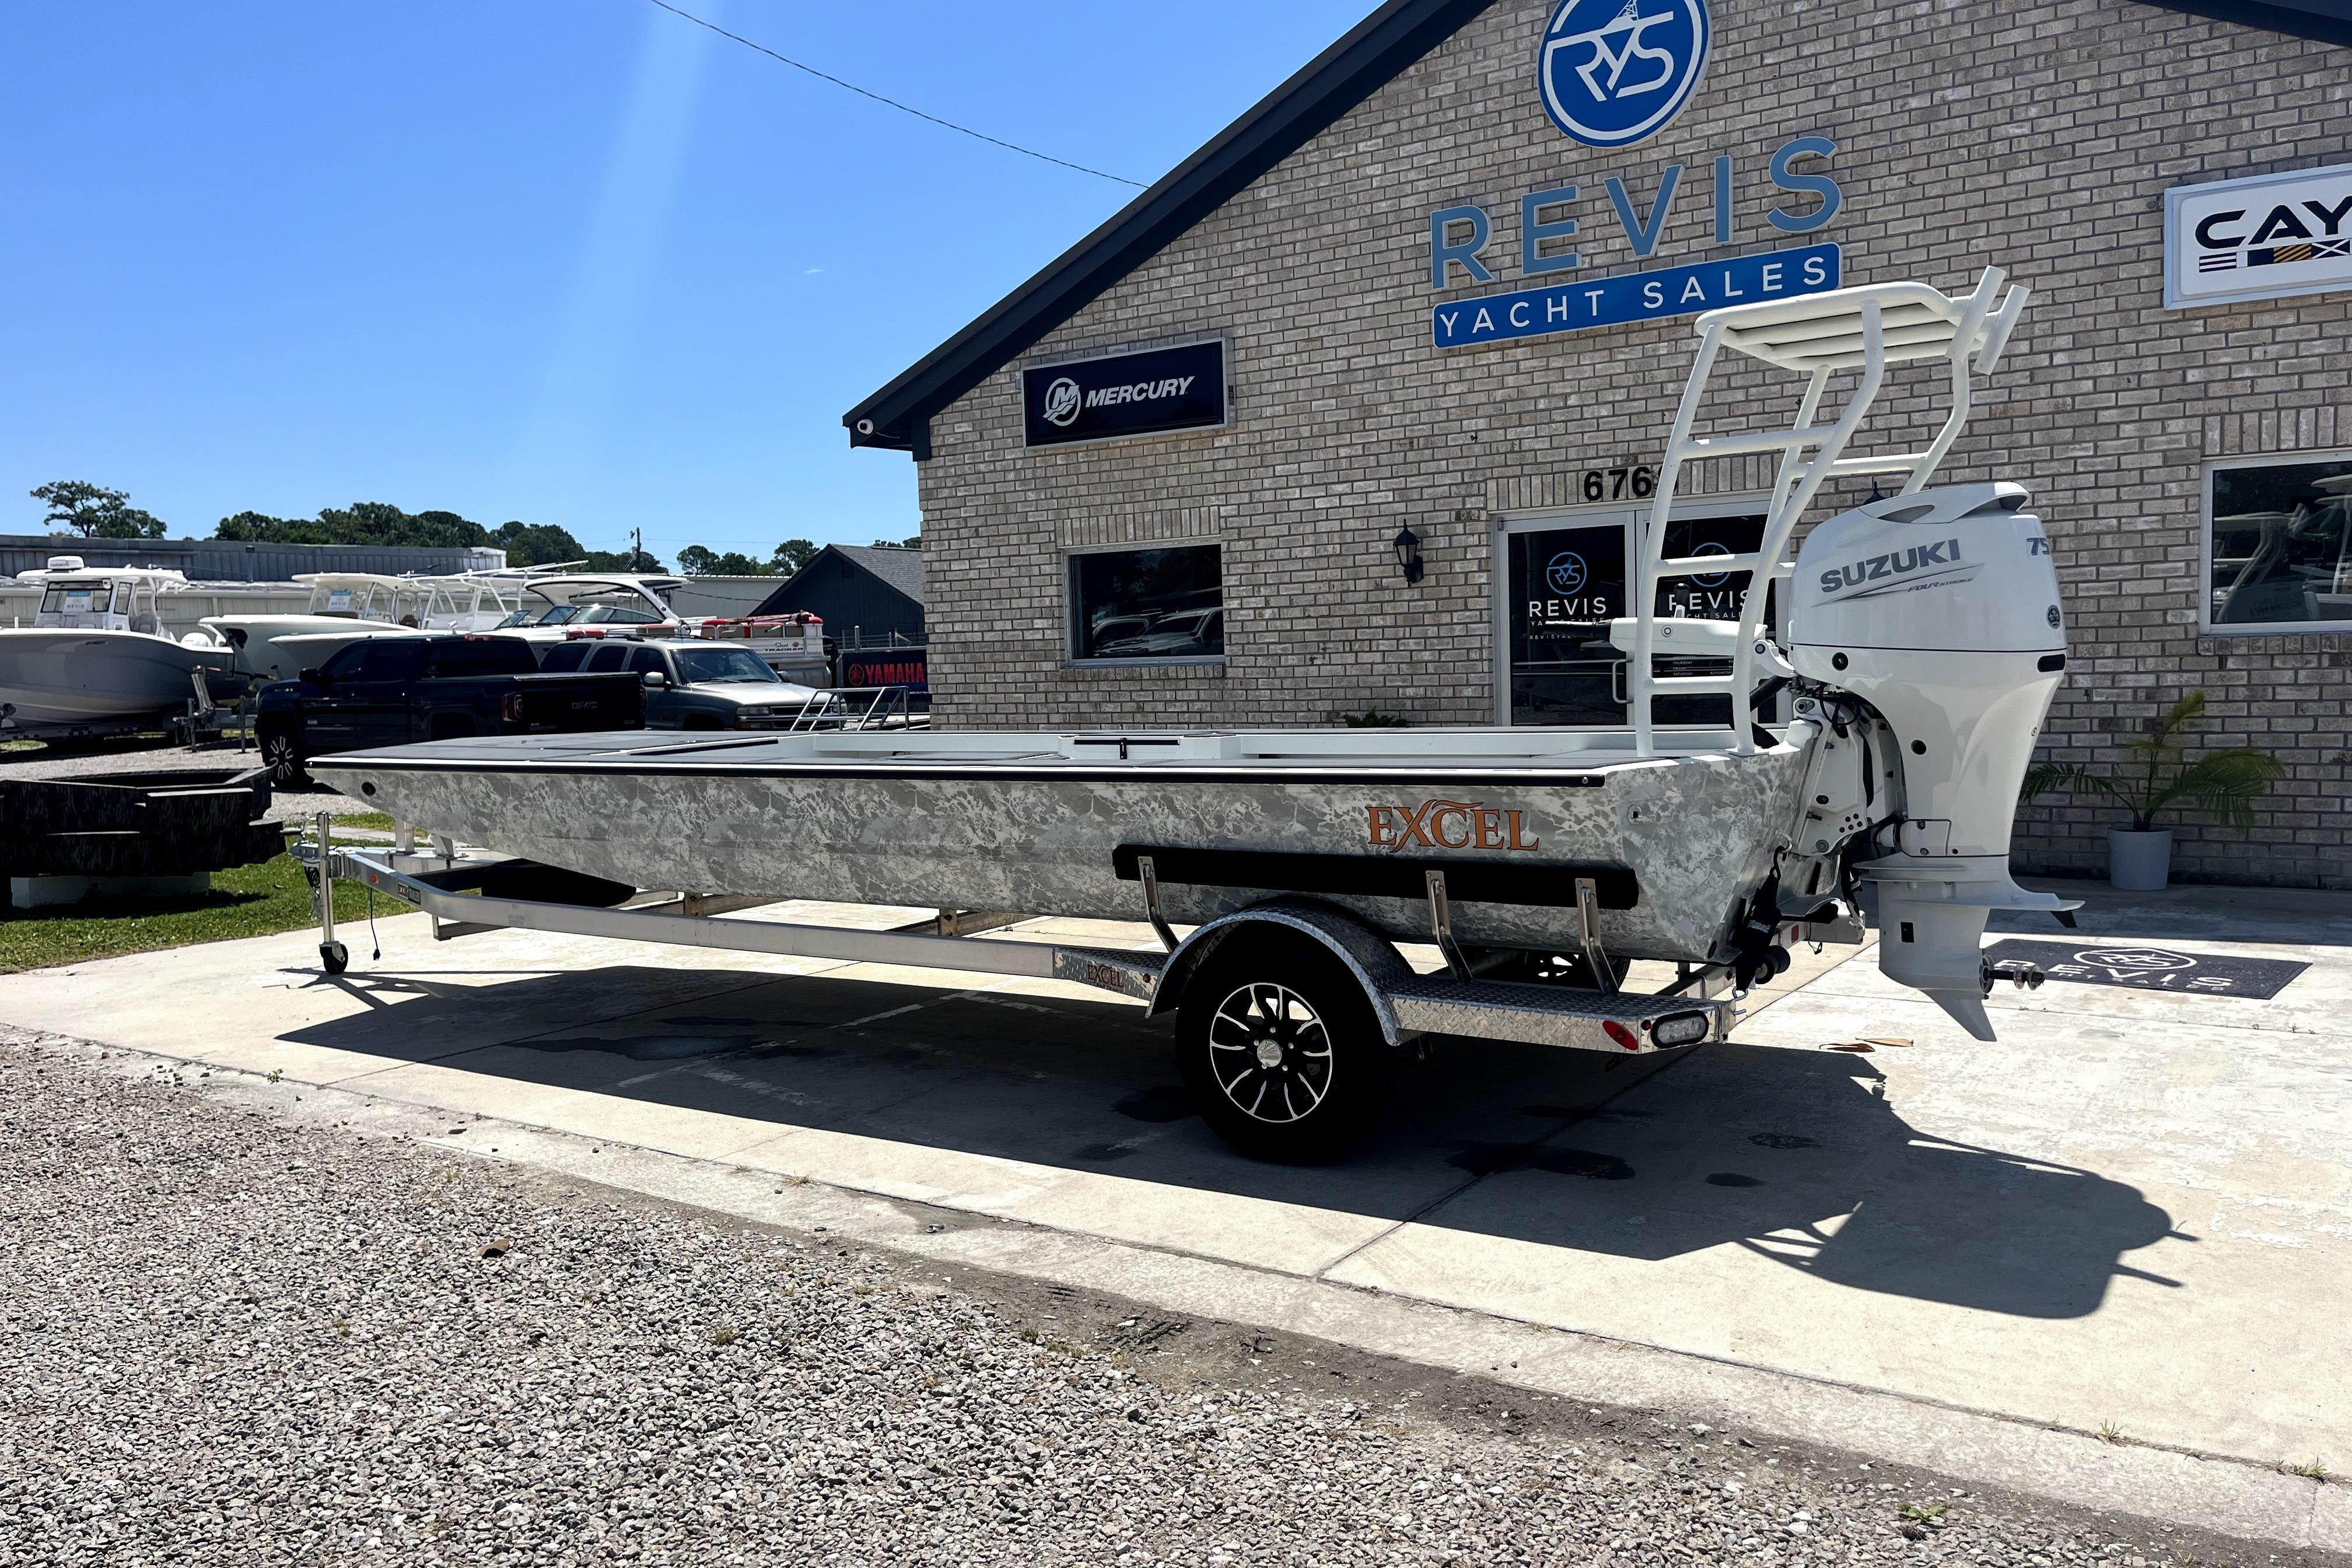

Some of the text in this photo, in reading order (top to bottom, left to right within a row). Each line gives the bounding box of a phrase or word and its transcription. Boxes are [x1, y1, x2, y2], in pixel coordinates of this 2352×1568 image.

[1430, 136, 1844, 290] REVIS
[1439, 256, 1826, 337] YACHT SALES
[1085, 376, 1195, 408] MERCURY
[1584, 465, 1678, 501] 676
[1821, 538, 1961, 593] SUZUKI
[1529, 597, 1606, 617] REVIS
[865, 663, 925, 684] YAMAHA
[1365, 799, 1539, 853] EXCEL
[1087, 964, 1124, 988] EXCEL
